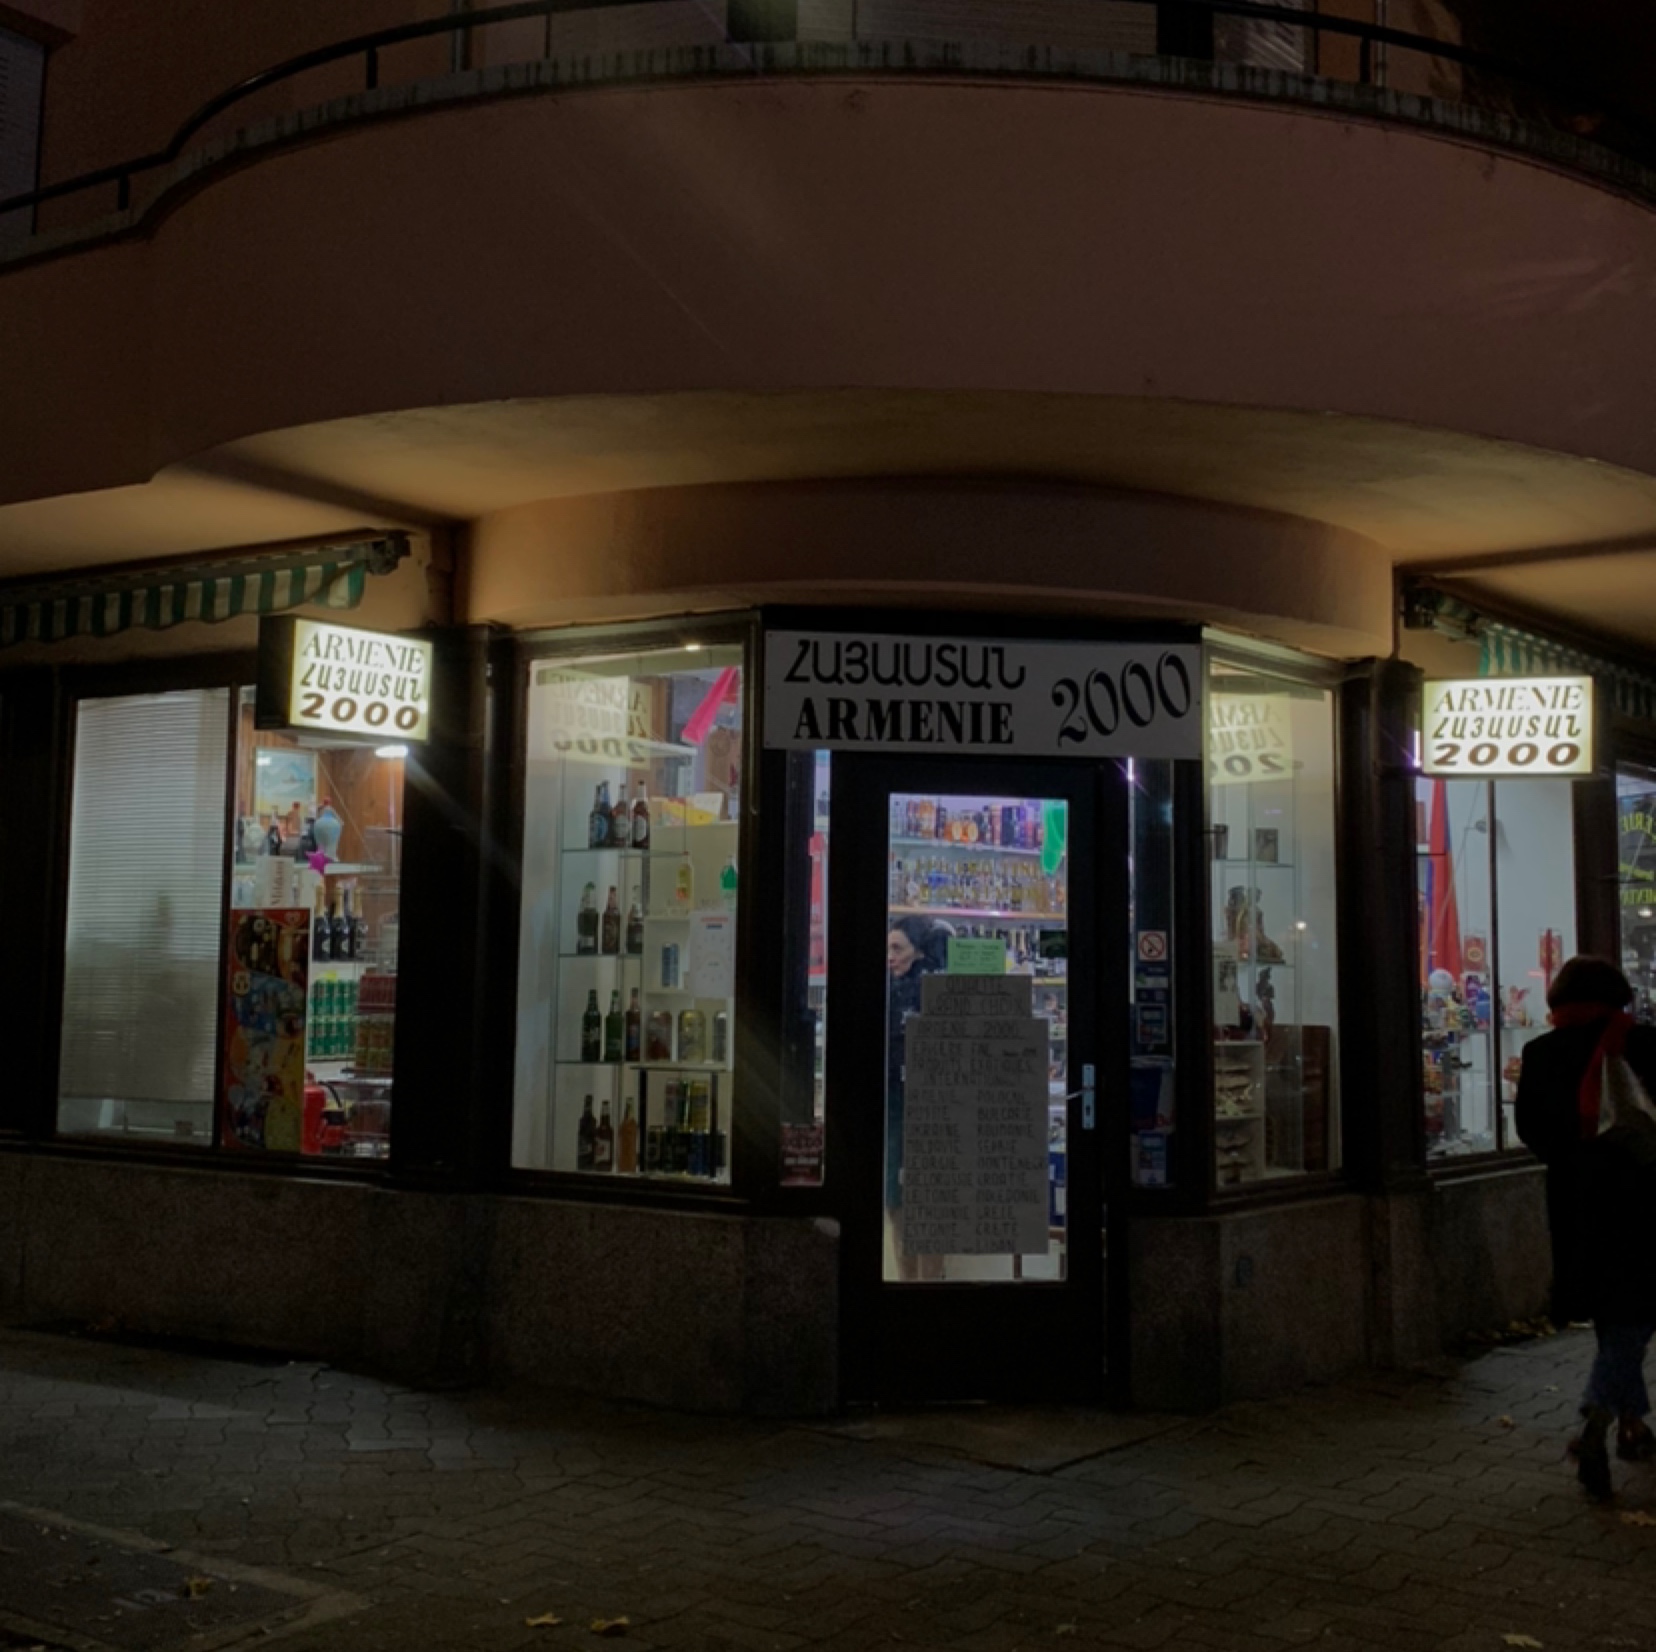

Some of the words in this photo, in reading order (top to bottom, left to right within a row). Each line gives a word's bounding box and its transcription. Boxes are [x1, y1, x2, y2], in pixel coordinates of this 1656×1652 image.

[302, 631, 424, 673] ARMENIE
[783, 640, 1026, 690] ՀԱՅԱՍՏԱՆ
[300, 663, 422, 702] ՀԱՅԱՍՏԱՆ
[1050, 650, 1192, 748] 2000
[1434, 684, 1584, 712] ARMENIE
[300, 692, 420, 730] 2000
[794, 697, 1014, 744] ARMENIE
[1432, 715, 1581, 740] ՀԱՅԱՍՏԱՆ
[1433, 742, 1581, 766] 2000
